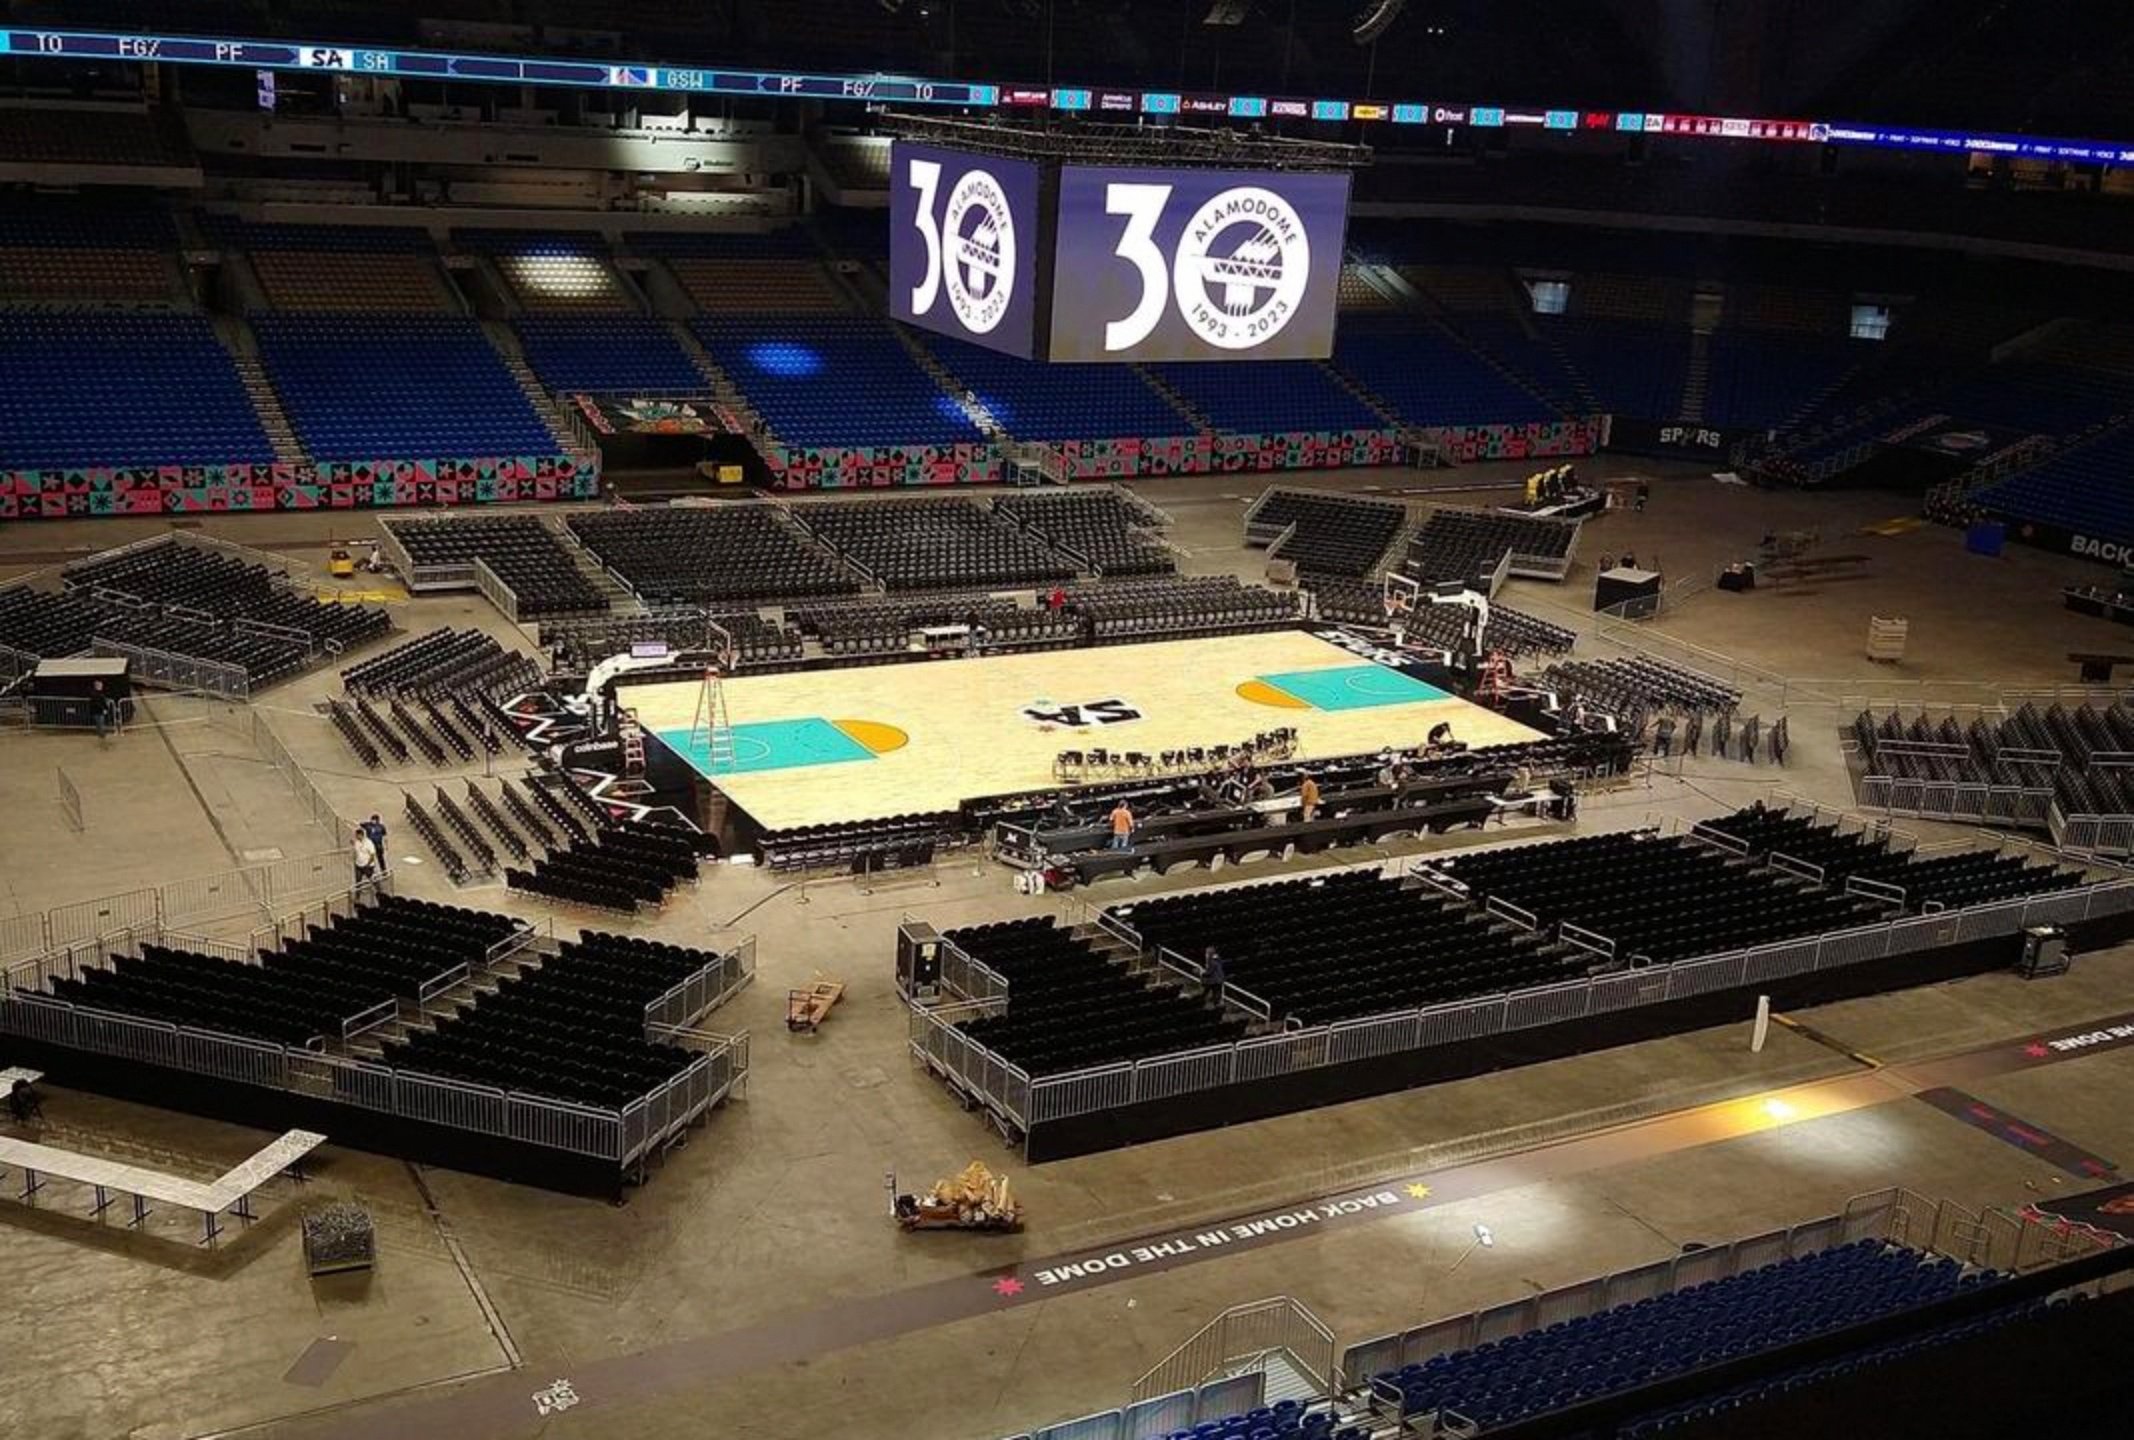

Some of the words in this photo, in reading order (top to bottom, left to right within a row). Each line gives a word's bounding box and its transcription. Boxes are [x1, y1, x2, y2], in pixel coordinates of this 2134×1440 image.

[36, 34, 63, 53] TO
[215, 43, 243, 61] PF
[312, 50, 343, 67] SA
[667, 70, 703, 89] GSW
[780, 76, 803, 94] PF
[914, 84, 933, 100] TO
[1192, 100, 1226, 111] ASHLEY
[1194, 198, 1297, 245] ALAMODOME
[1191, 303, 1228, 338] 1993
[1247, 300, 1289, 337] 2023
[2071, 534, 2133, 568] BACK
[2048, 1031, 2114, 1051] DOME
[1316, 1191, 1401, 1217] BACK
[1235, 1210, 1323, 1240] HOME
[1131, 1239, 1197, 1264] THE
[1195, 1229, 1230, 1249] IN
[1034, 1254, 1132, 1286] DOME
